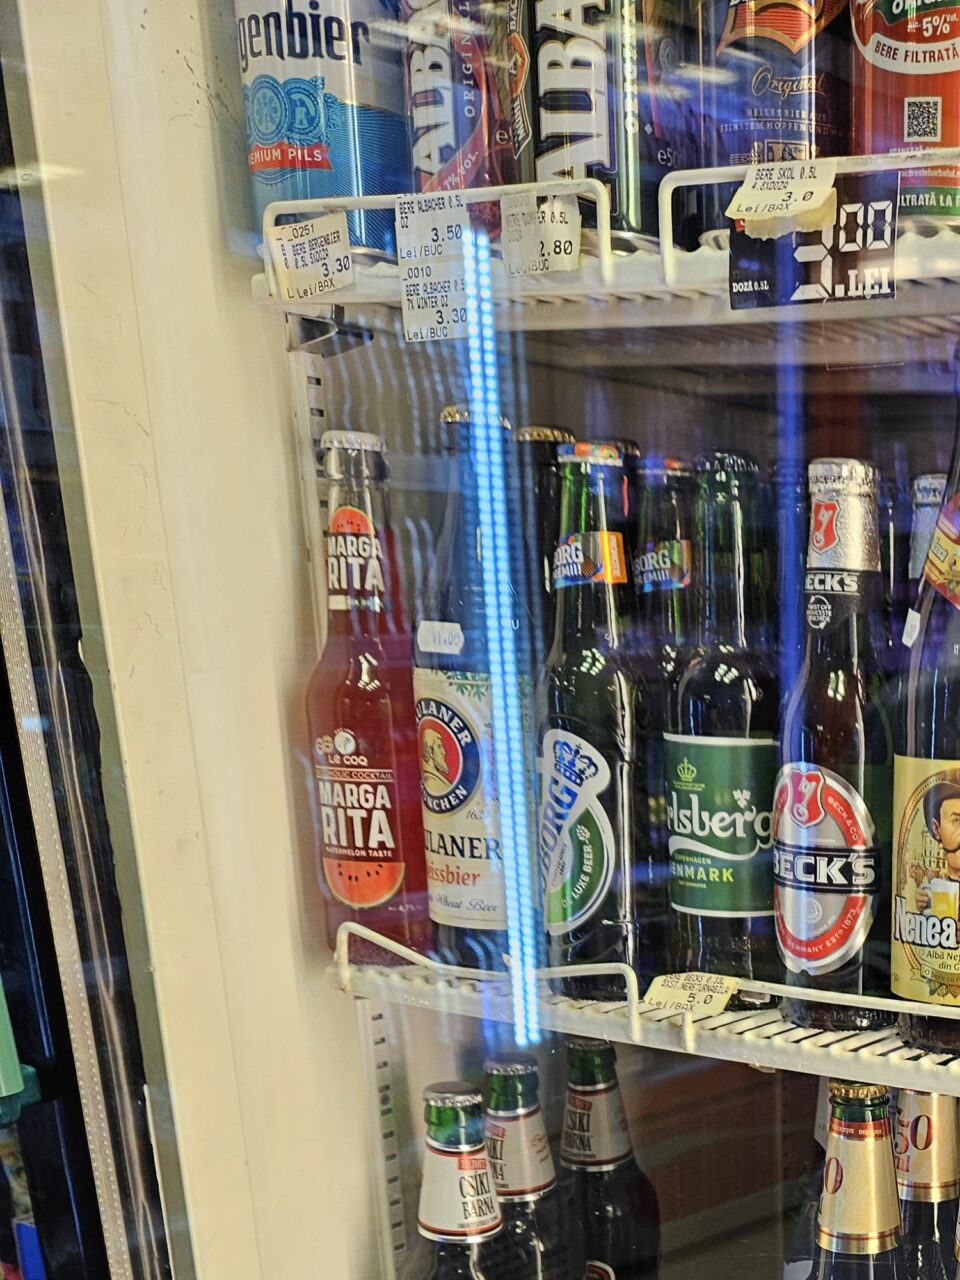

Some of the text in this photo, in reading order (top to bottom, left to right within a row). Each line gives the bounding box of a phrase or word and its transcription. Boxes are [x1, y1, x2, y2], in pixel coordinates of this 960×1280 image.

[922, 16, 950, 38] 5%
[874, 41, 898, 61] BERE
[904, 45, 960, 64] FILTRATĂ
[752, 65, 826, 99] Original
[288, 149, 322, 162] PILS
[755, 166, 817, 181] BERE SKOL 0.5L
[399, 202, 417, 215] BERE
[418, 197, 446, 213] ALBACHER
[781, 190, 814, 203] 3.0
[550, 211, 569, 225] 0.5L
[839, 200, 894, 253] 00
[292, 229, 341, 257] BERE BERGENBIER
[432, 224, 462, 243] 3.50
[400, 245, 443, 260] Lei/BUC
[322, 255, 350, 277] 3.30
[296, 276, 336, 300] Lei/BAX
[406, 282, 452, 298] BERE ALBACHER
[732, 281, 753, 294] DOZĂ
[847, 266, 891, 297] LEI
[436, 307, 467, 325] 3.30
[407, 327, 448, 341] Lei/BUC
[328, 555, 385, 592] RITA
[343, 755, 368, 767] COQ
[319, 780, 392, 809] MARGA
[321, 806, 396, 849] RITA
[368, 849, 393, 858] TASTE
[573, 842, 594, 901] LUXE BEER
[773, 851, 876, 885] BECK'S
[467, 898, 499, 912] Beer
[894, 896, 957, 951] Nenea
[926, 950, 946, 962] Albă
[938, 961, 952, 971] din
[686, 992, 713, 1004] 5.0
[459, 1170, 491, 1199] CSÍKI
[463, 1195, 495, 1220] BARNA
